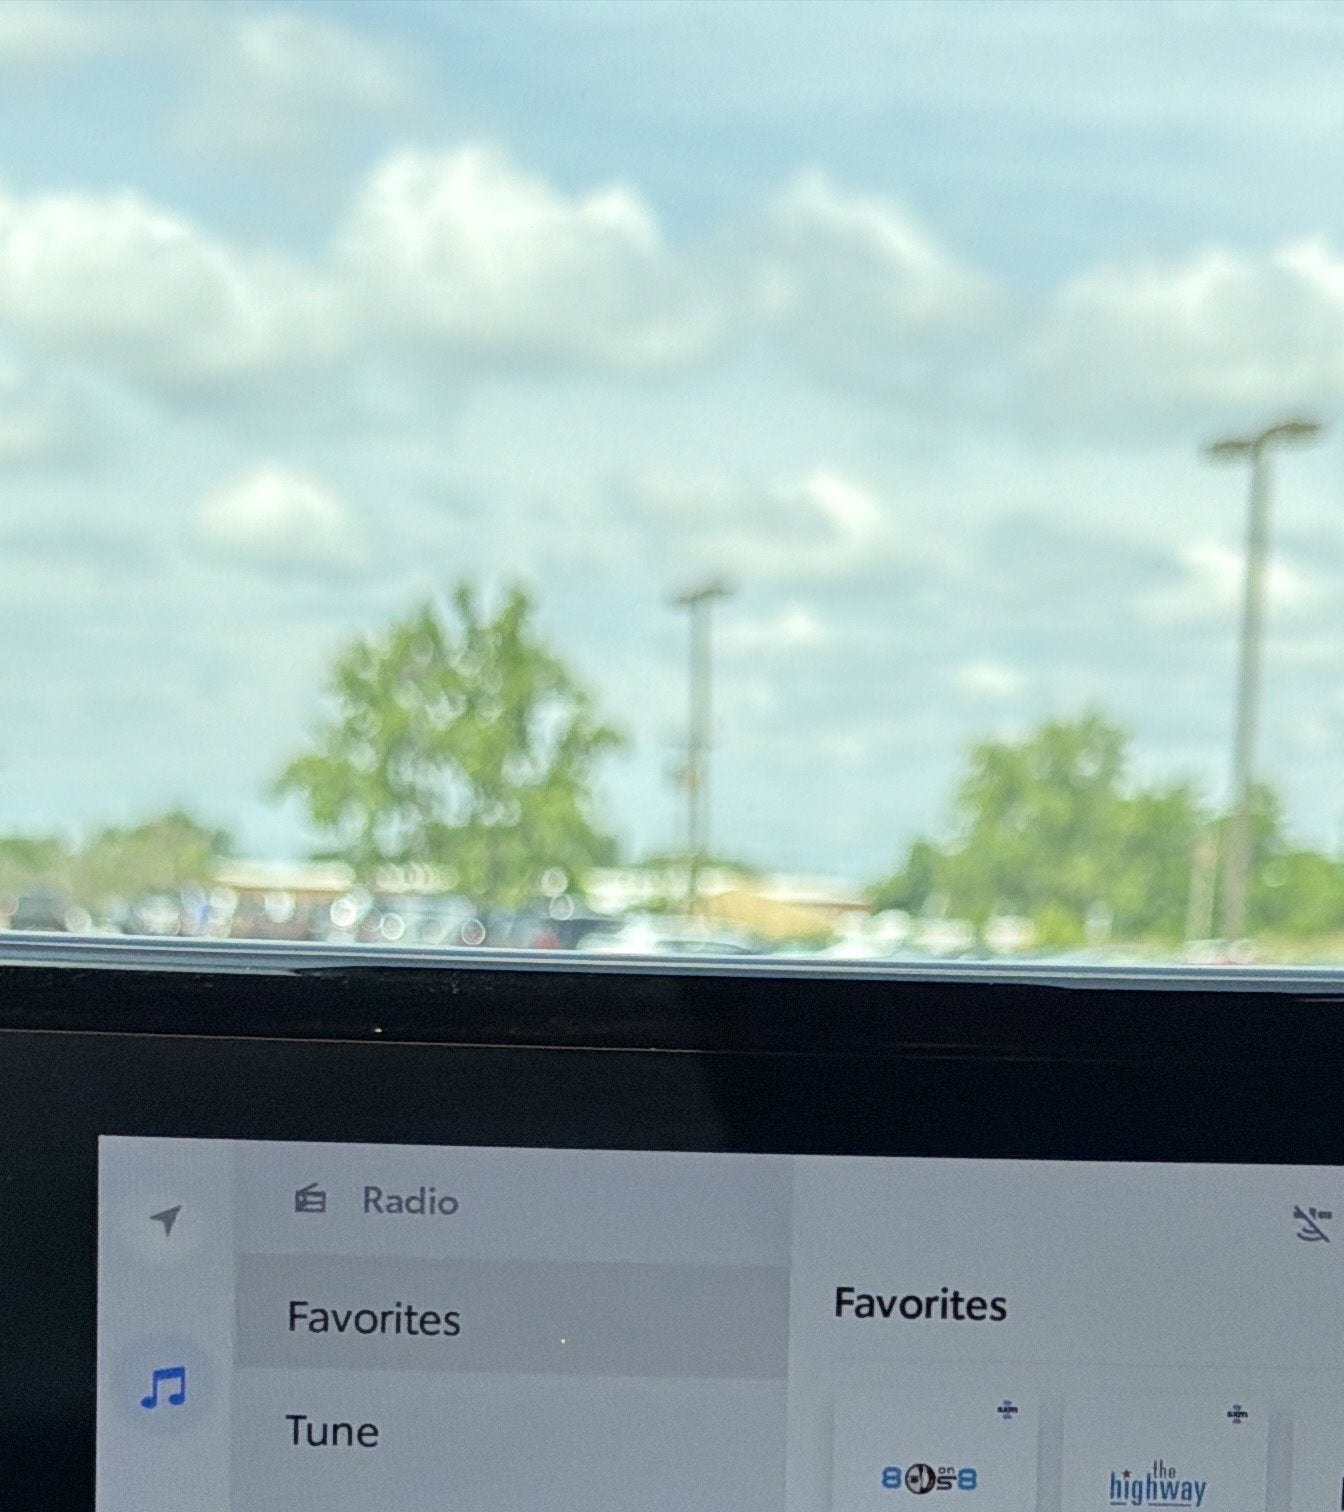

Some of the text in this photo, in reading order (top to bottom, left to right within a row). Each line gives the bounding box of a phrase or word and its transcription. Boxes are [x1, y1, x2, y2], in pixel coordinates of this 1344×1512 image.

[363, 1185, 459, 1216] Radio
[289, 1300, 461, 1337] Favorites
[835, 1286, 1007, 1322] Favorites
[285, 1414, 379, 1448] Tune
[1109, 1467, 1207, 1508] highway
